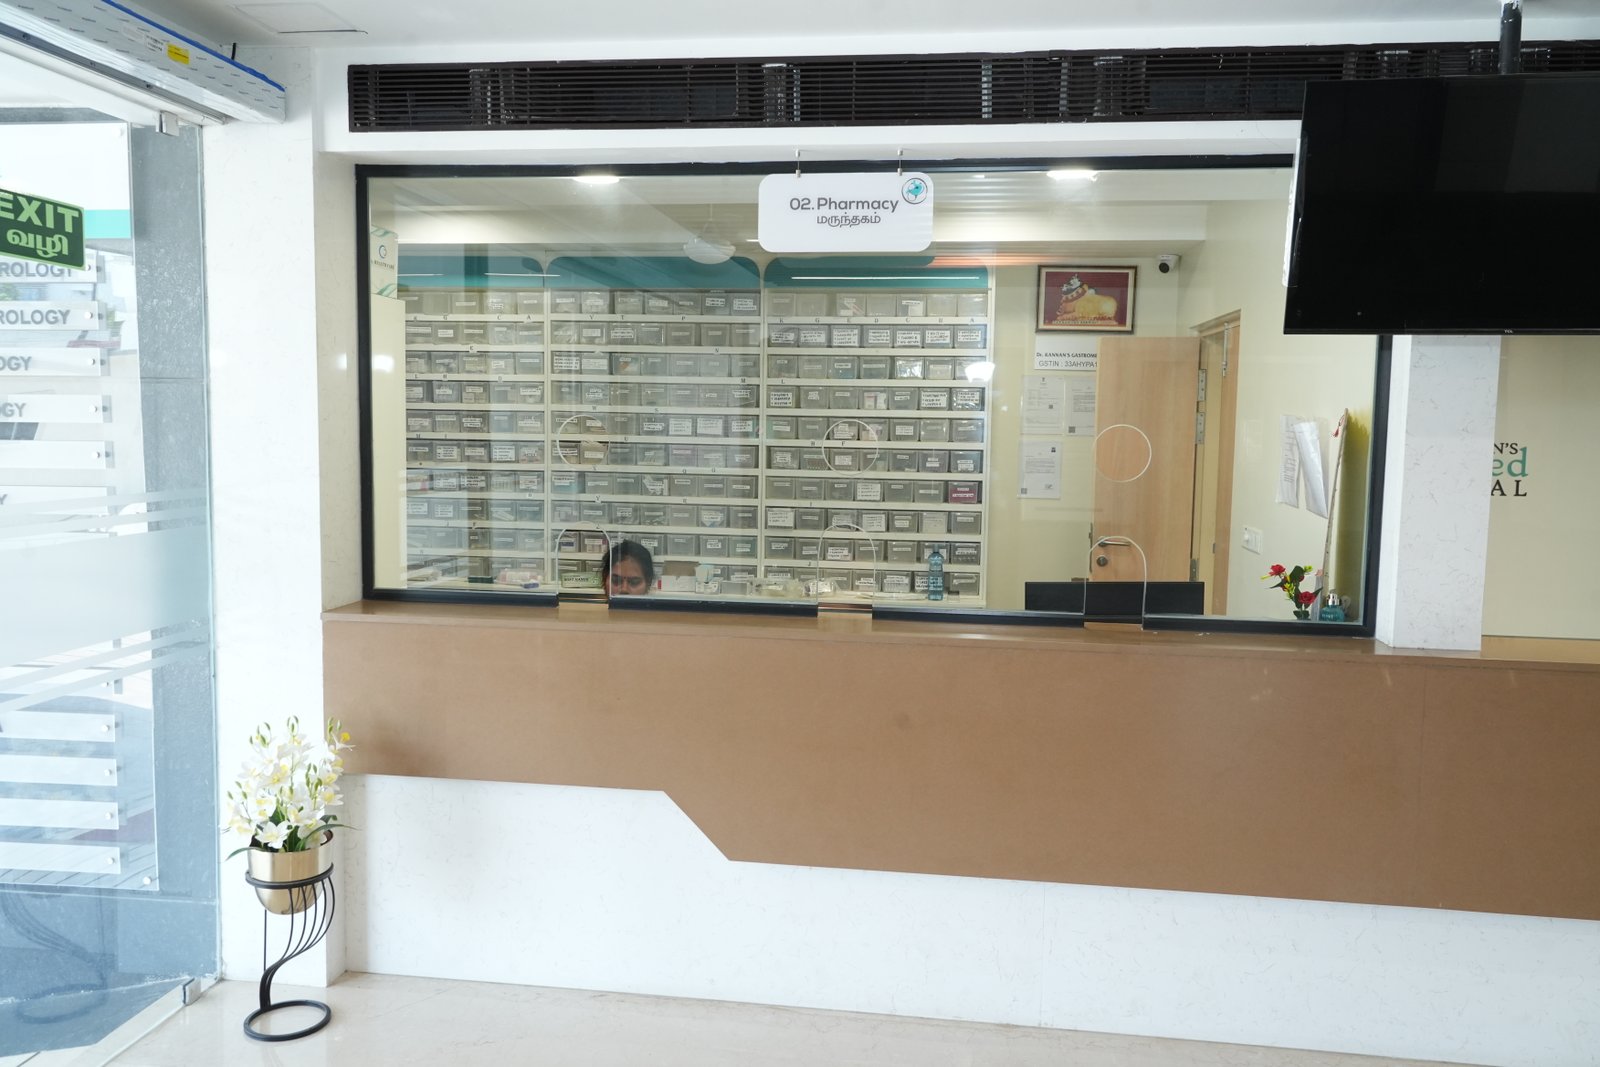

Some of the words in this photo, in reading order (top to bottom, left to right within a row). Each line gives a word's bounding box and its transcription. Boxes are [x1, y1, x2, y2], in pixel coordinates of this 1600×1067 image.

[0, 191, 79, 233] EXIT
[816, 212, 882, 228] மருந்தகம்
[6, 229, 69, 258] வழி
